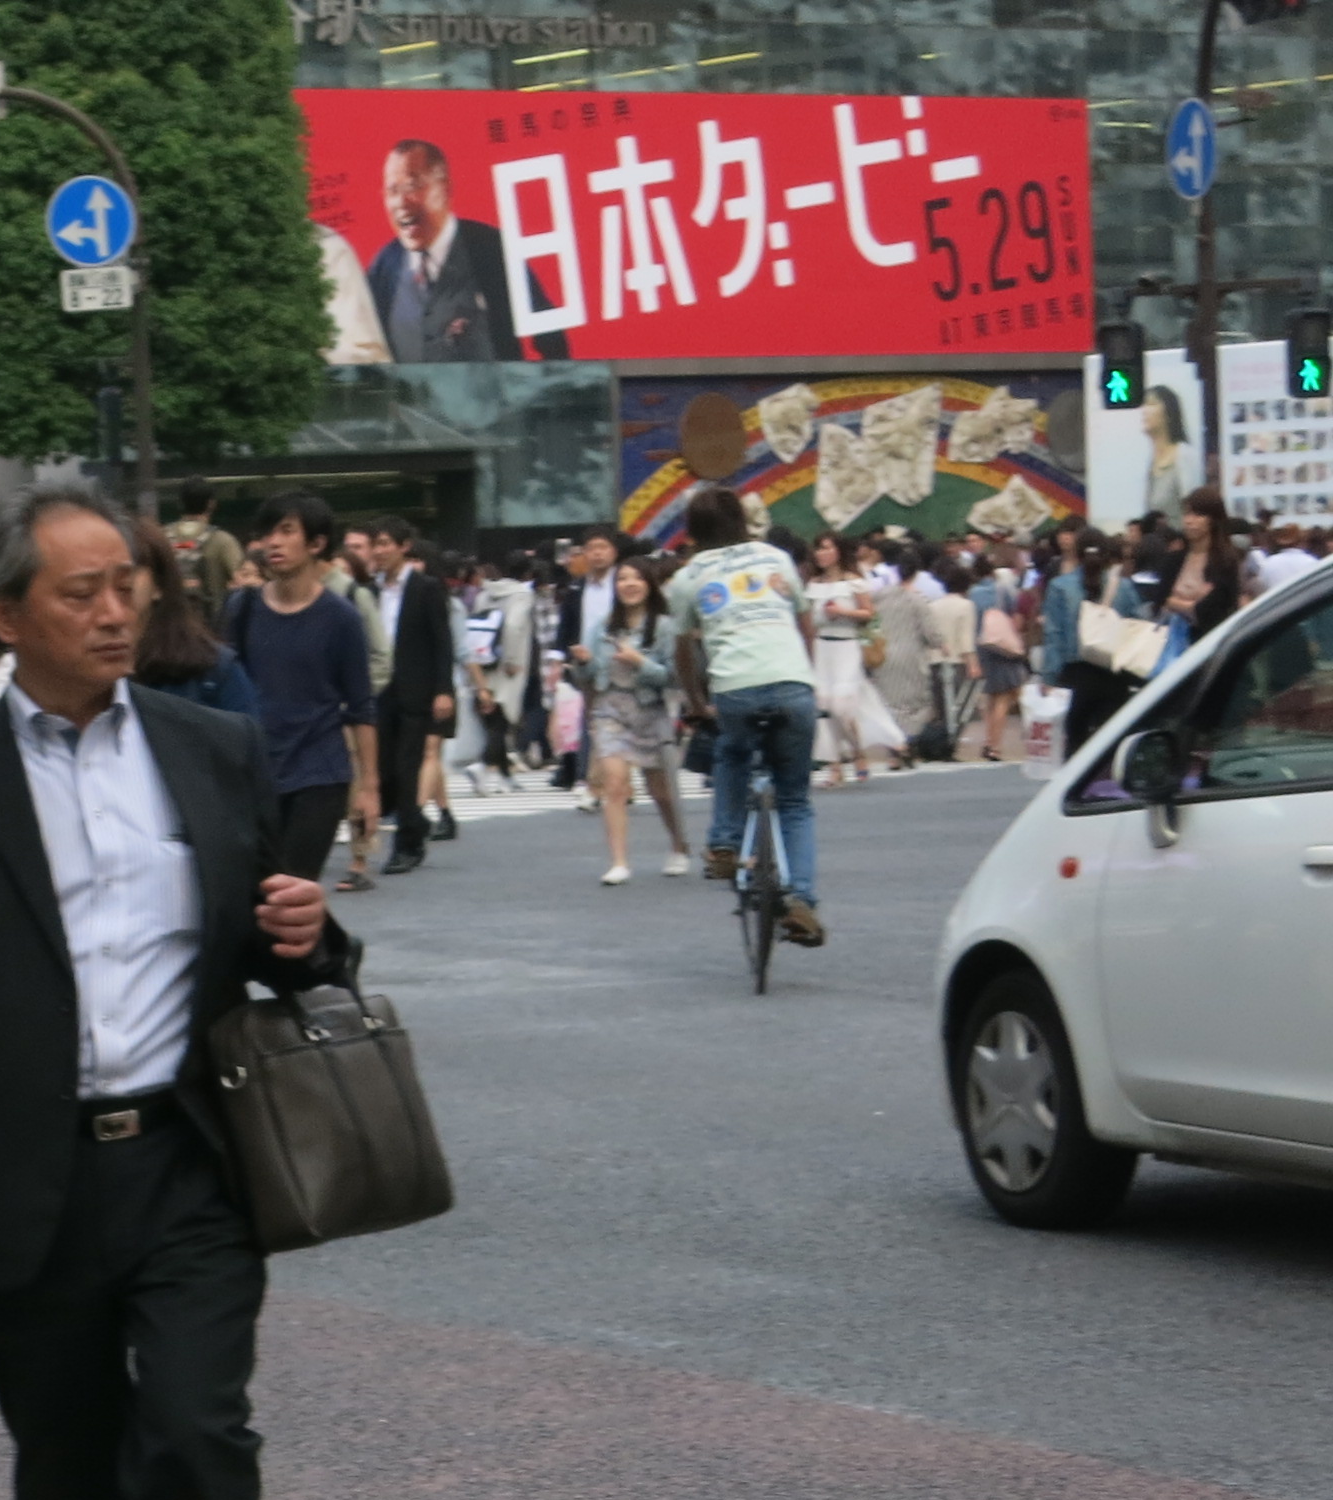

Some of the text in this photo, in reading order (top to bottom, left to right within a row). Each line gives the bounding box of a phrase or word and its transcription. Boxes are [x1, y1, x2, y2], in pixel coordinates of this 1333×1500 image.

[491, 95, 982, 339] 日本ダービー
[924, 180, 1055, 302] 5.29
